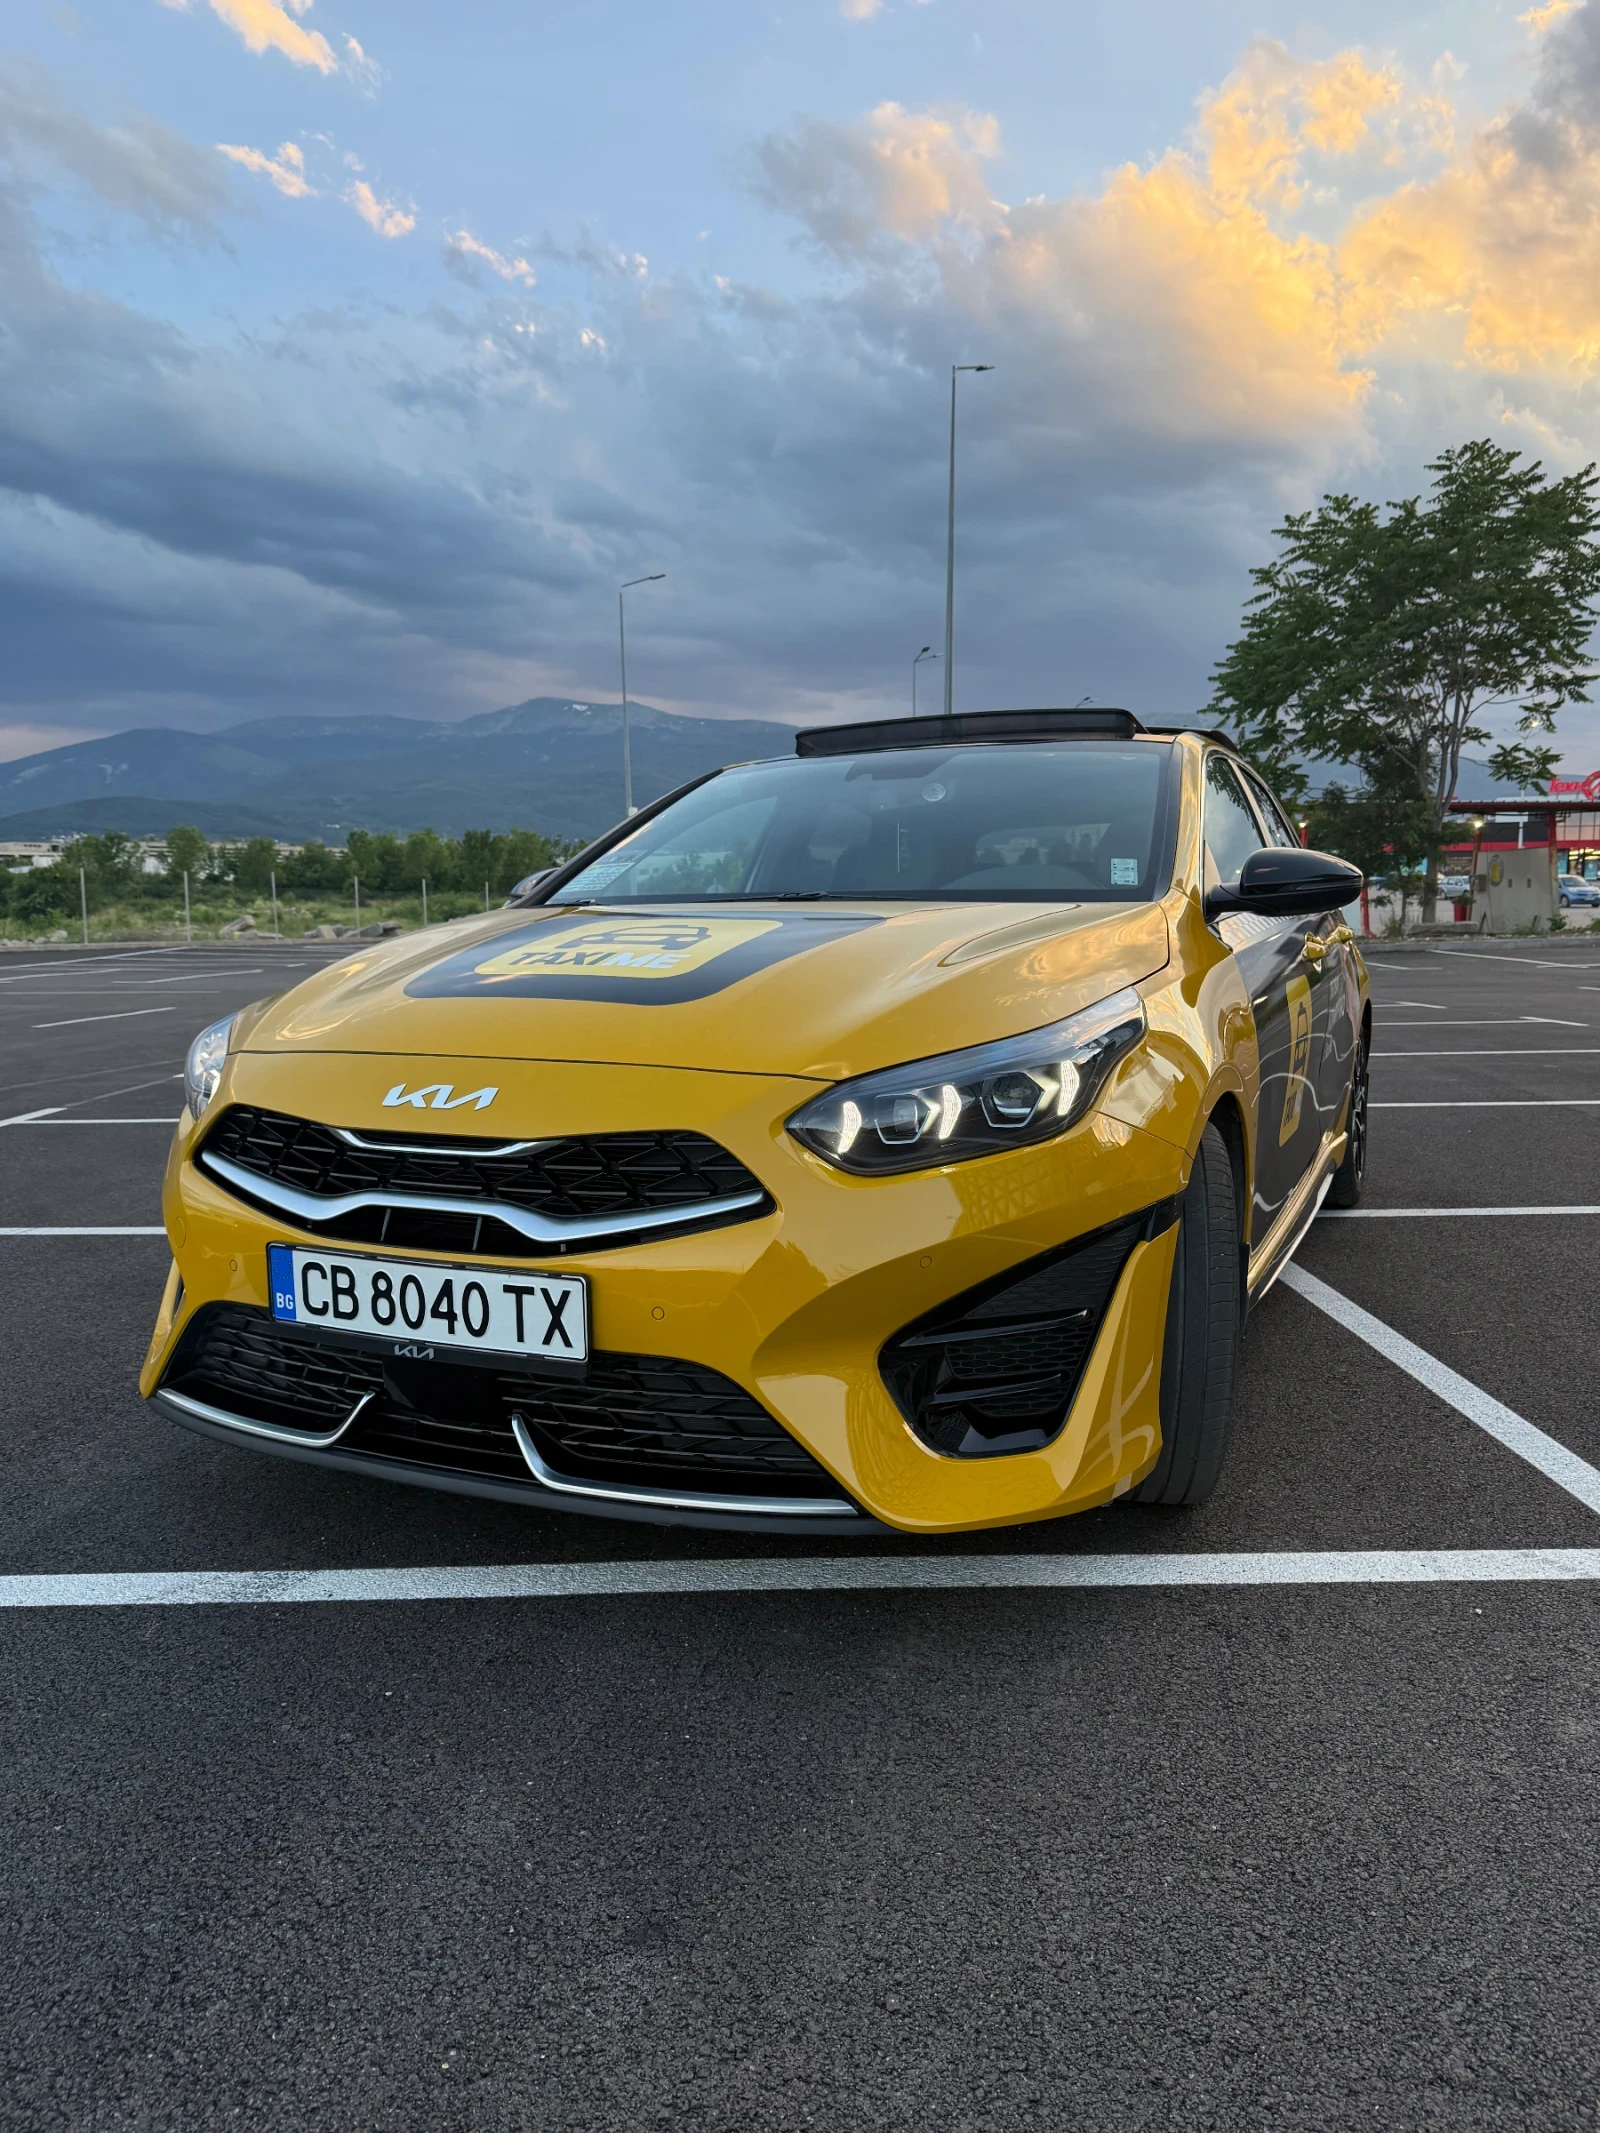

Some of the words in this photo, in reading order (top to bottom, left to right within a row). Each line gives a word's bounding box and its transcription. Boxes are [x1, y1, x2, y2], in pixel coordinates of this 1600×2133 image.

[508, 951, 691, 969] TAXIME
[381, 1083, 499, 1111] KIA
[276, 1292, 294, 1310] BG
[301, 1261, 360, 1321] CB
[371, 1270, 490, 1338] 8040
[502, 1283, 574, 1349] TX
